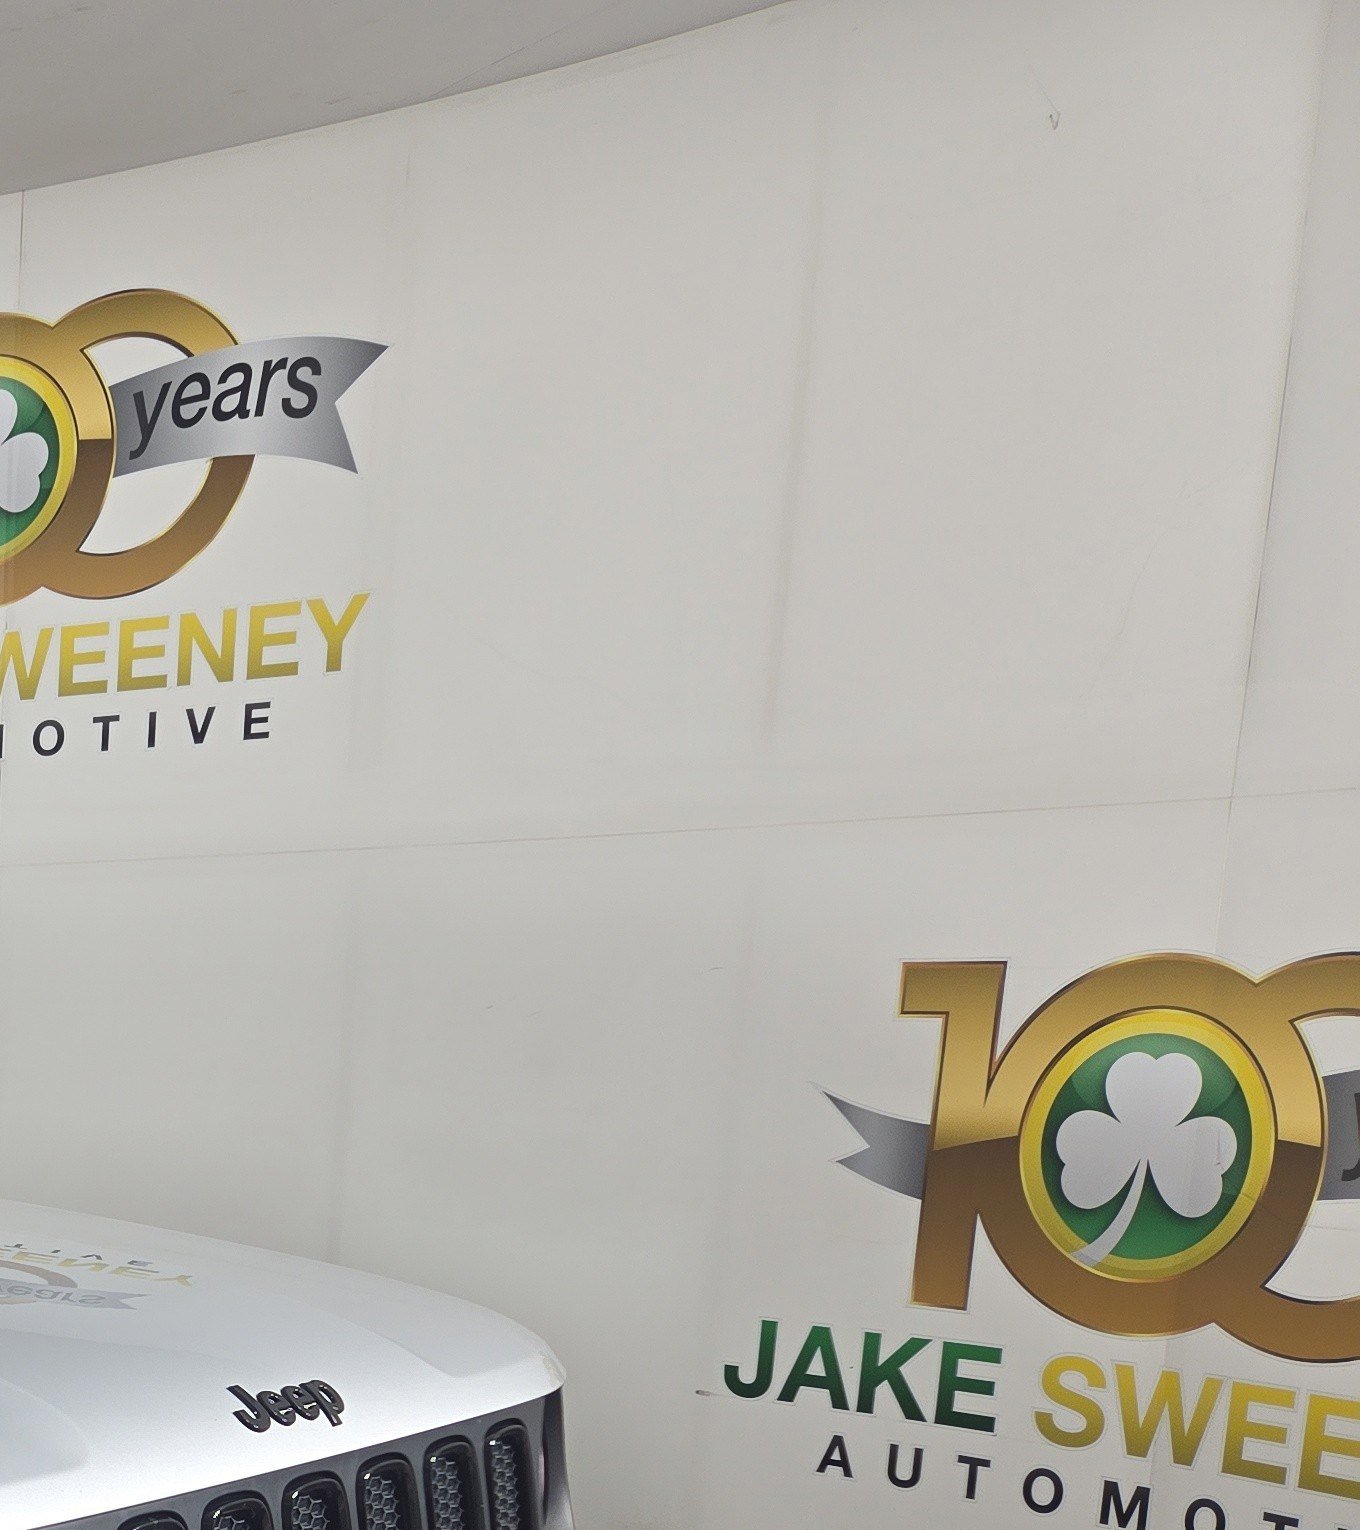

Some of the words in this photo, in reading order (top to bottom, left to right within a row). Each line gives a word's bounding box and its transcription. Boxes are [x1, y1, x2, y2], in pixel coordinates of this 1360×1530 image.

[129, 352, 322, 461] years
[226, 1379, 345, 1434] Jeep
[723, 1319, 1003, 1435] JAKE
